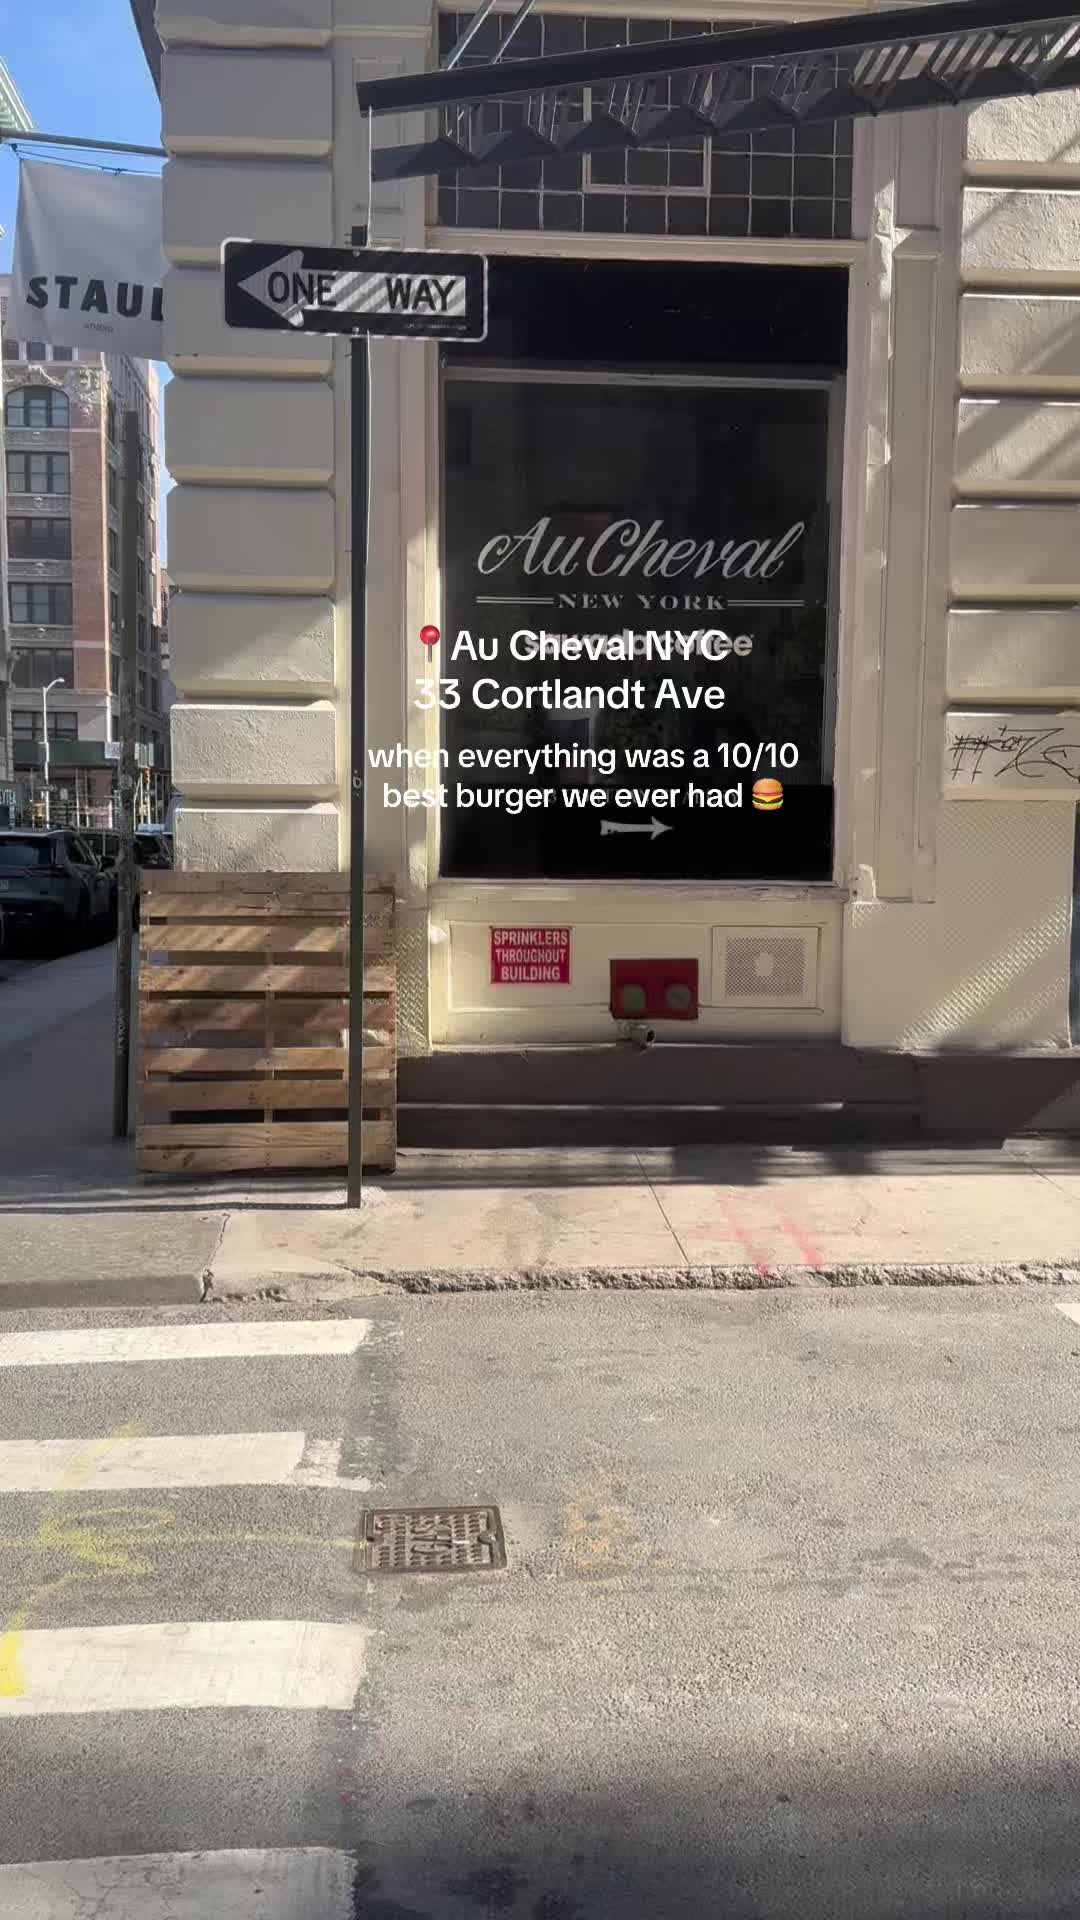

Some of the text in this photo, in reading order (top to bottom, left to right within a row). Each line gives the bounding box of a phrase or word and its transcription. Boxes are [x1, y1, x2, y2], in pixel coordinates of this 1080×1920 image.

[267, 271, 456, 312] ONE WAY
[477, 516, 805, 579] Au Cheval
[557, 593, 727, 611] NEW YORK
[494, 930, 568, 946] SPRINKLERS
[495, 947, 566, 963] THROUGHOUT
[501, 965, 560, 981] BUILDING
